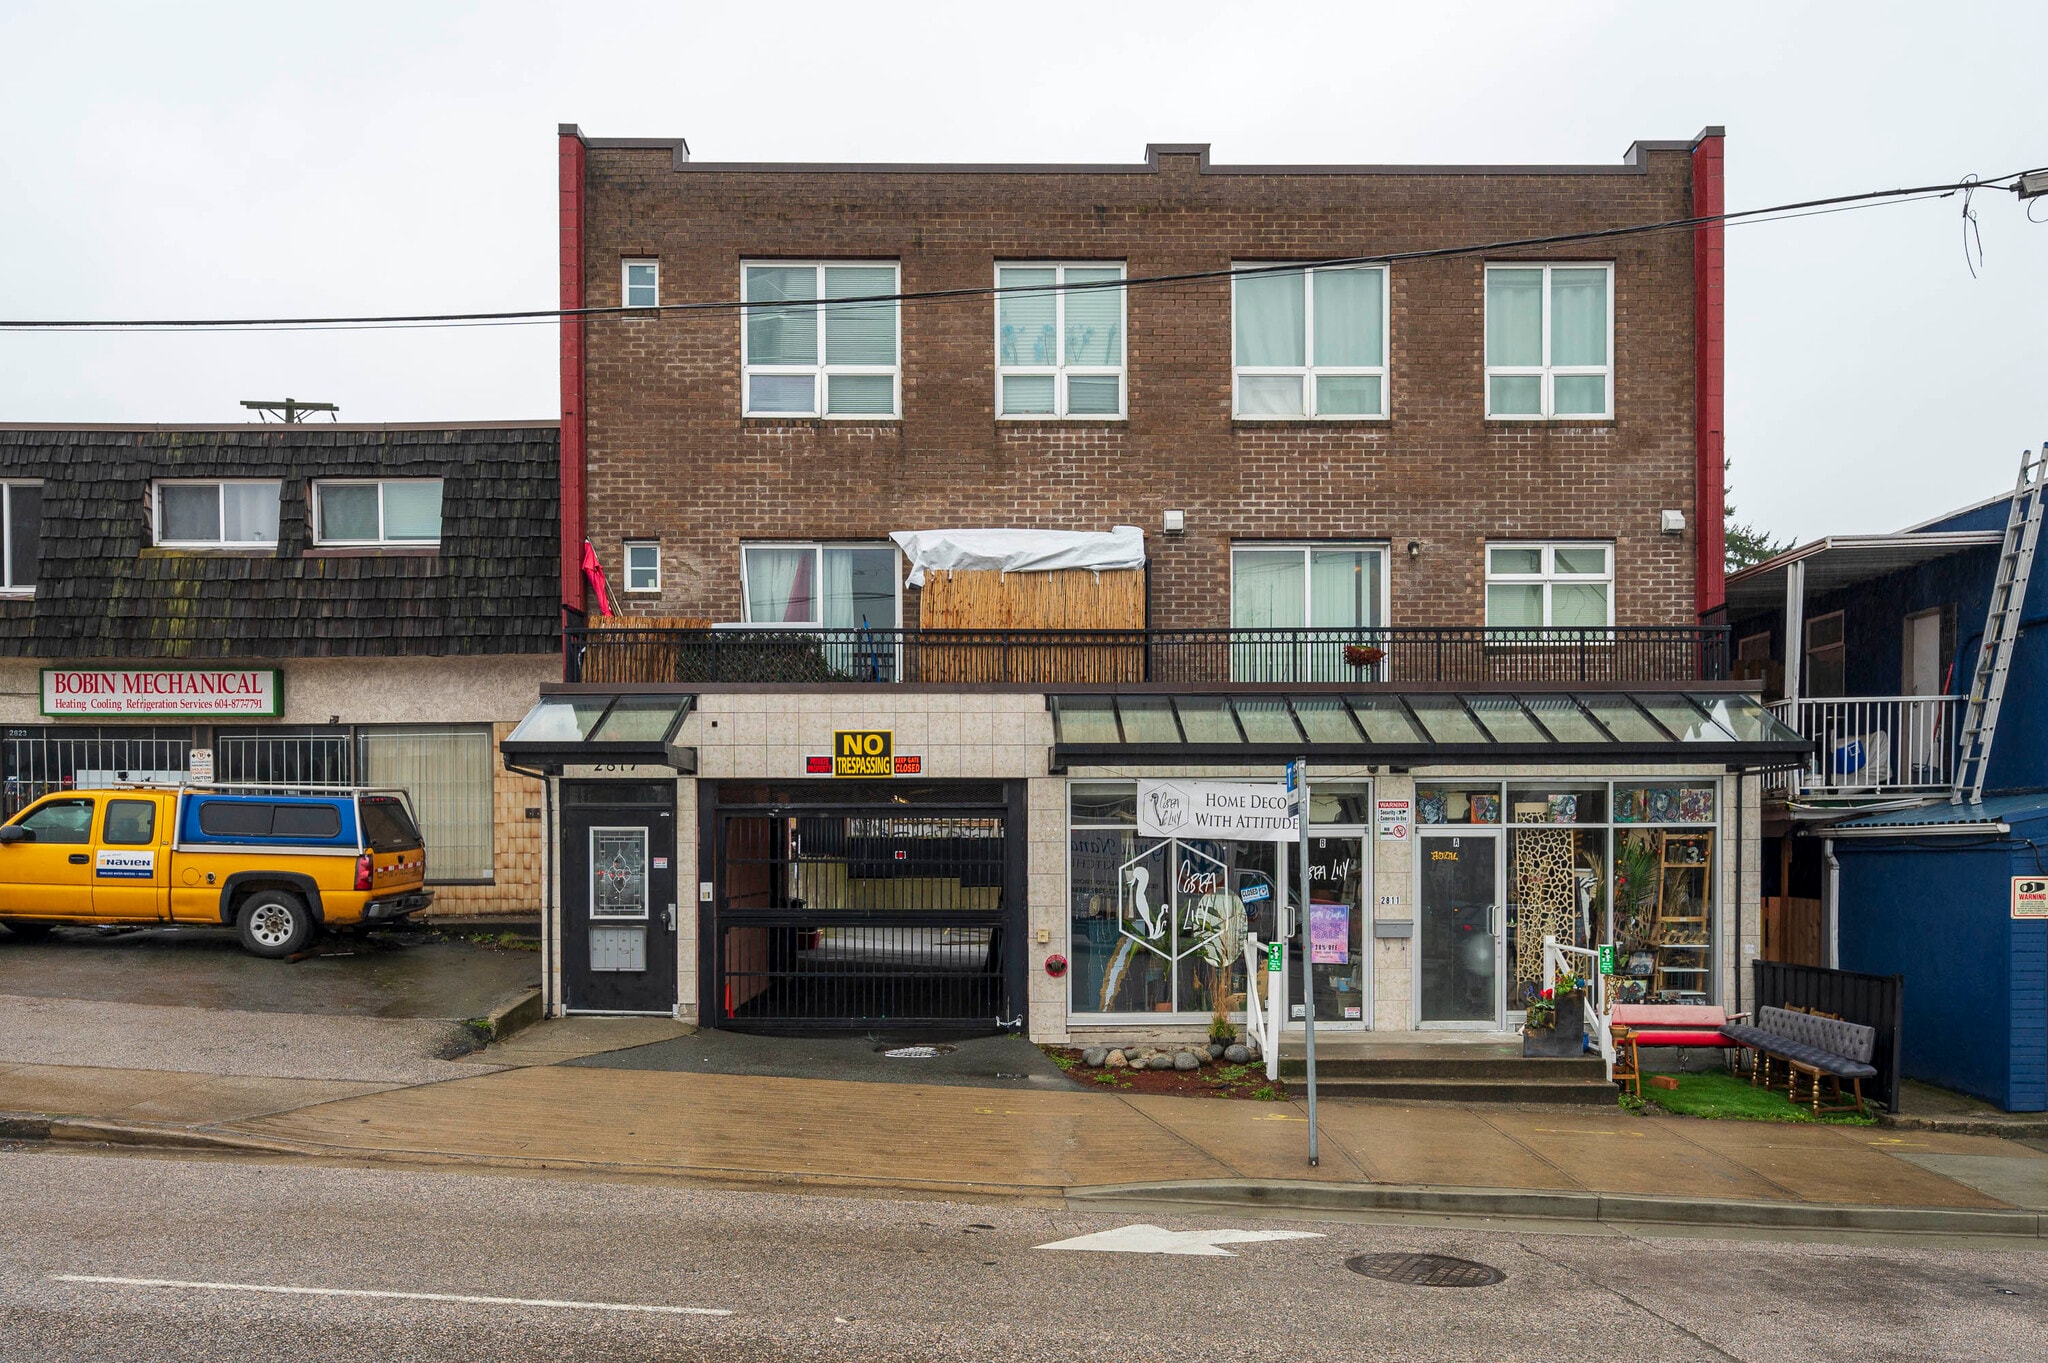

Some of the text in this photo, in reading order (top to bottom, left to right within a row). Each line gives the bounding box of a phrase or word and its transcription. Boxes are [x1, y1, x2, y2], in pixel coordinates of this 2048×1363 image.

[54, 673, 263, 694] BOBIN MECHANICAL
[55, 699, 87, 711] Heating
[90, 699, 122, 711] Cooling
[126, 699, 178, 711] Refrigeration
[180, 700, 213, 709] Services
[843, 734, 884, 755] NO
[836, 757, 890, 774] TRESPASSING
[895, 764, 920, 773] CLOSED
[1205, 793, 1246, 808] HOME
[1251, 795, 1288, 810] DECO
[1195, 812, 1299, 830] WITH ATTITUDE
[1453, 838, 1459, 847] A
[1178, 860, 1216, 893] COBRA
[1331, 858, 1350, 880] LILY
[1242, 888, 1259, 898] CLOSED
[1381, 896, 1400, 904] 2811
